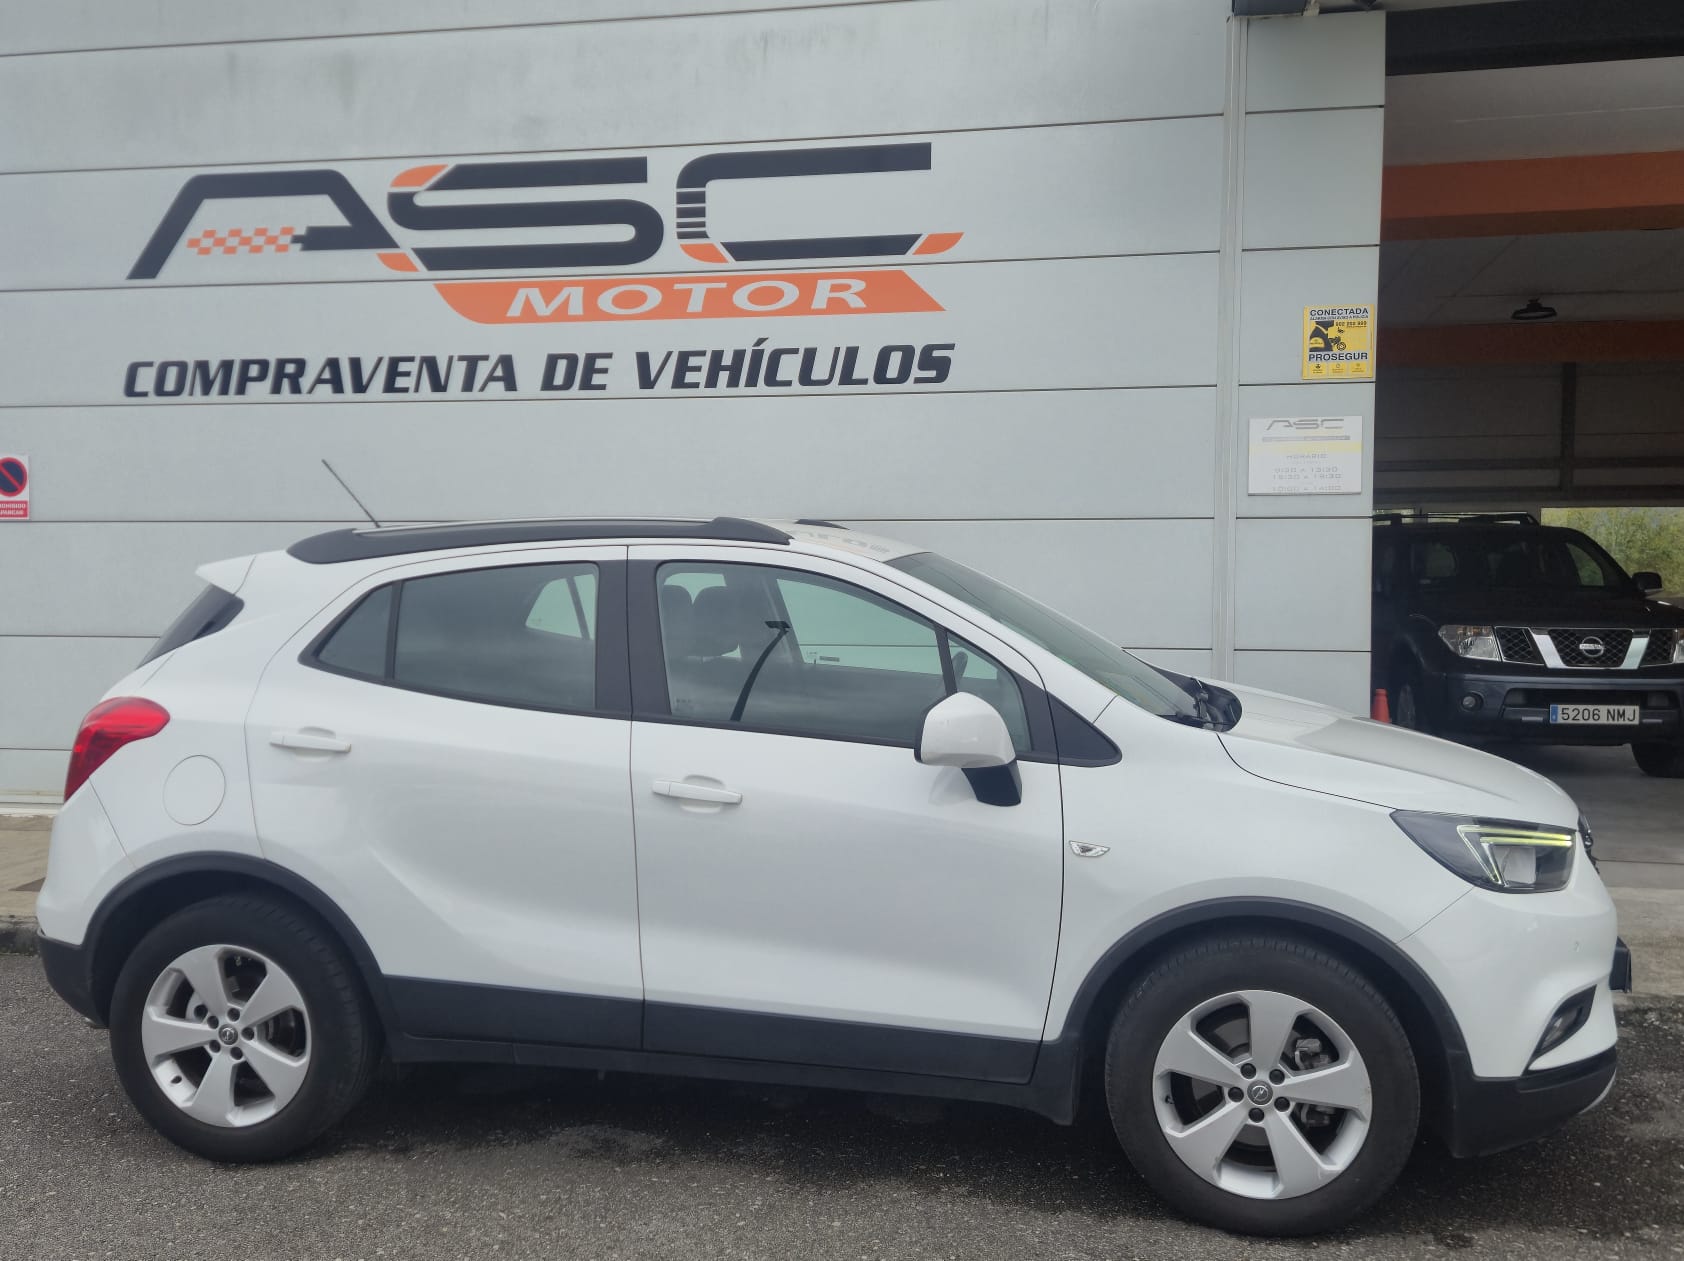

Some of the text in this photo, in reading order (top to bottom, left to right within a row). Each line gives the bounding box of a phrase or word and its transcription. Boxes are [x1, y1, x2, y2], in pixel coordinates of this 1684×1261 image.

[128, 142, 964, 280] ASC
[506, 278, 867, 317] MOTOR
[1310, 307, 1369, 317] CONECTADA
[125, 338, 955, 398] COMPRAVENTA DE VEHÍCULOS
[1308, 352, 1368, 362] PROSEGUR
[1561, 707, 1636, 721] 5206 NMJ
